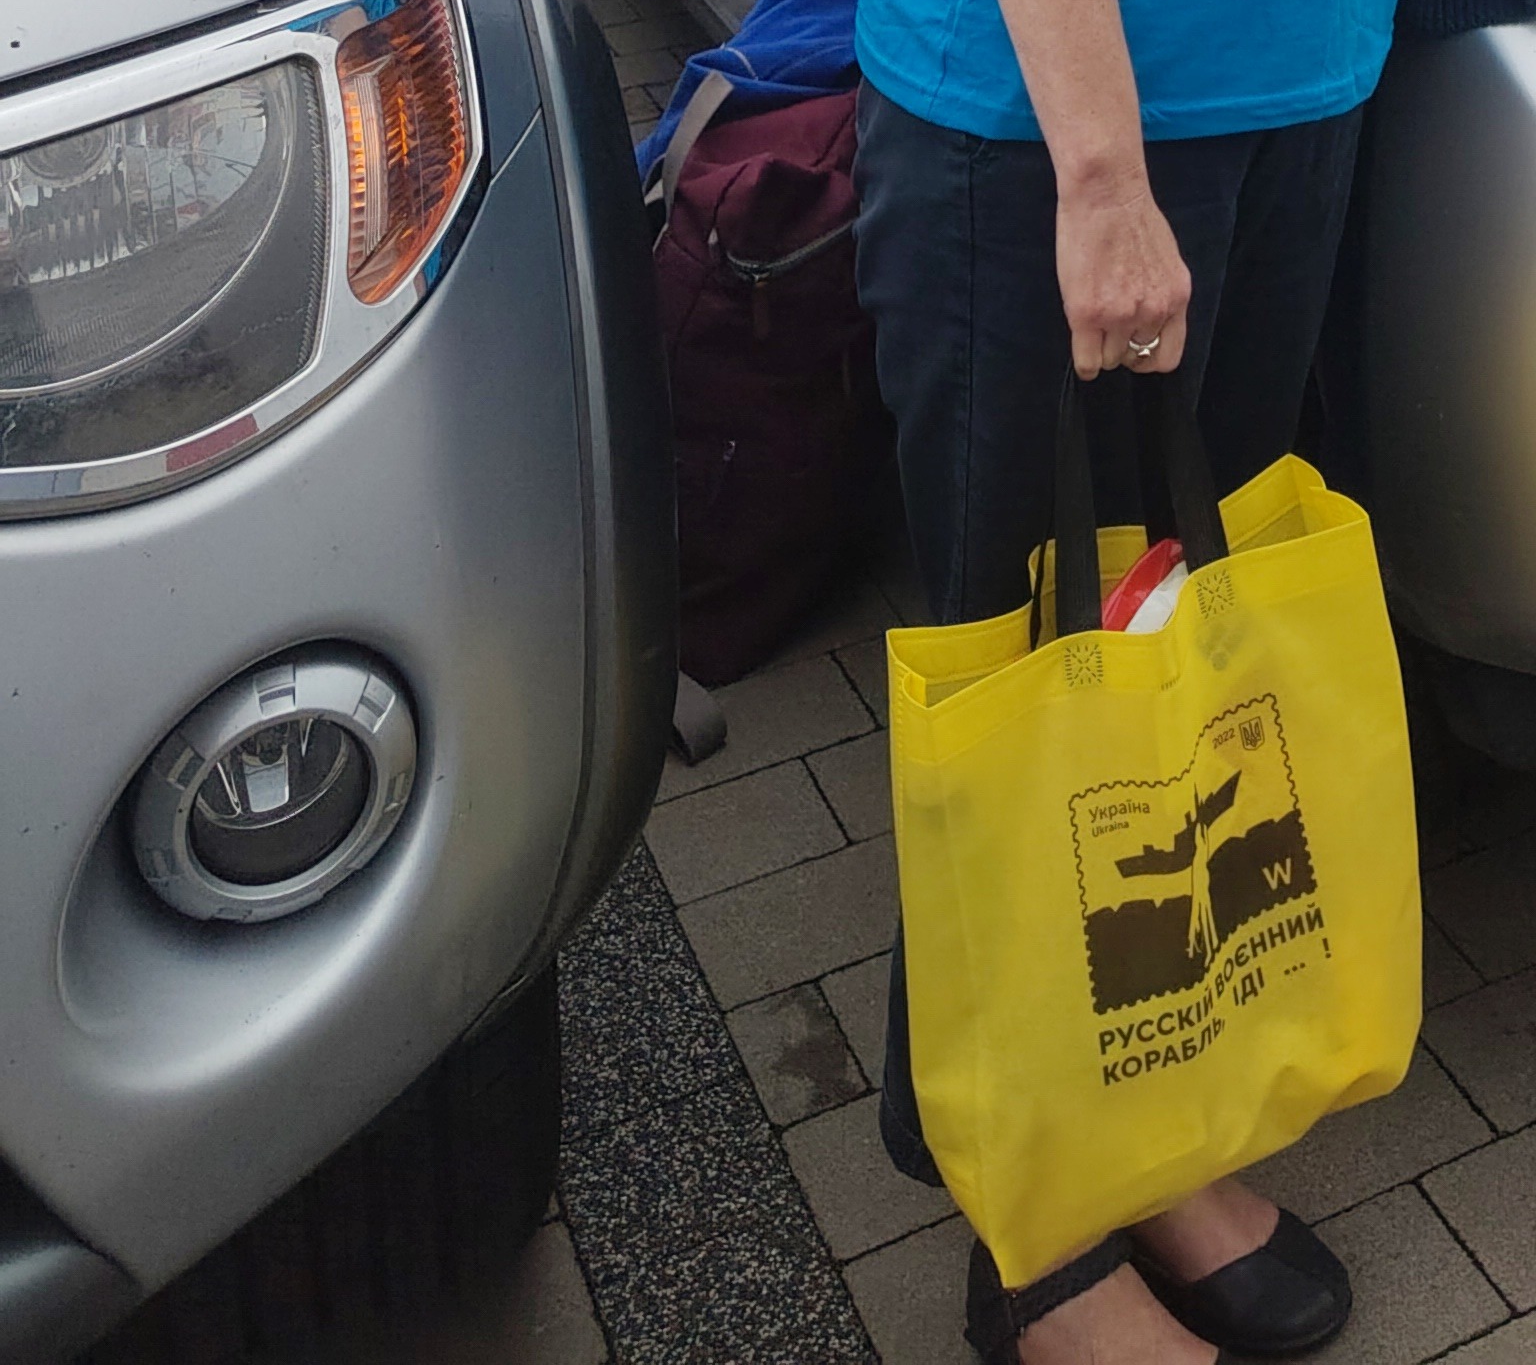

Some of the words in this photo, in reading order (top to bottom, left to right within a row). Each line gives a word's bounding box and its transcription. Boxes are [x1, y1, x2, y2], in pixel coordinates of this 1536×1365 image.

[1212, 727, 1236, 750] 2022
[1088, 799, 1151, 824] Україна
[1091, 819, 1130, 838] Ukraina
[1262, 857, 1292, 891] W
[1098, 986, 1214, 1056] РУССКІЙ
[1214, 901, 1325, 999] ВОЄННИЙ
[1232, 966, 1265, 1007] ІДІ
